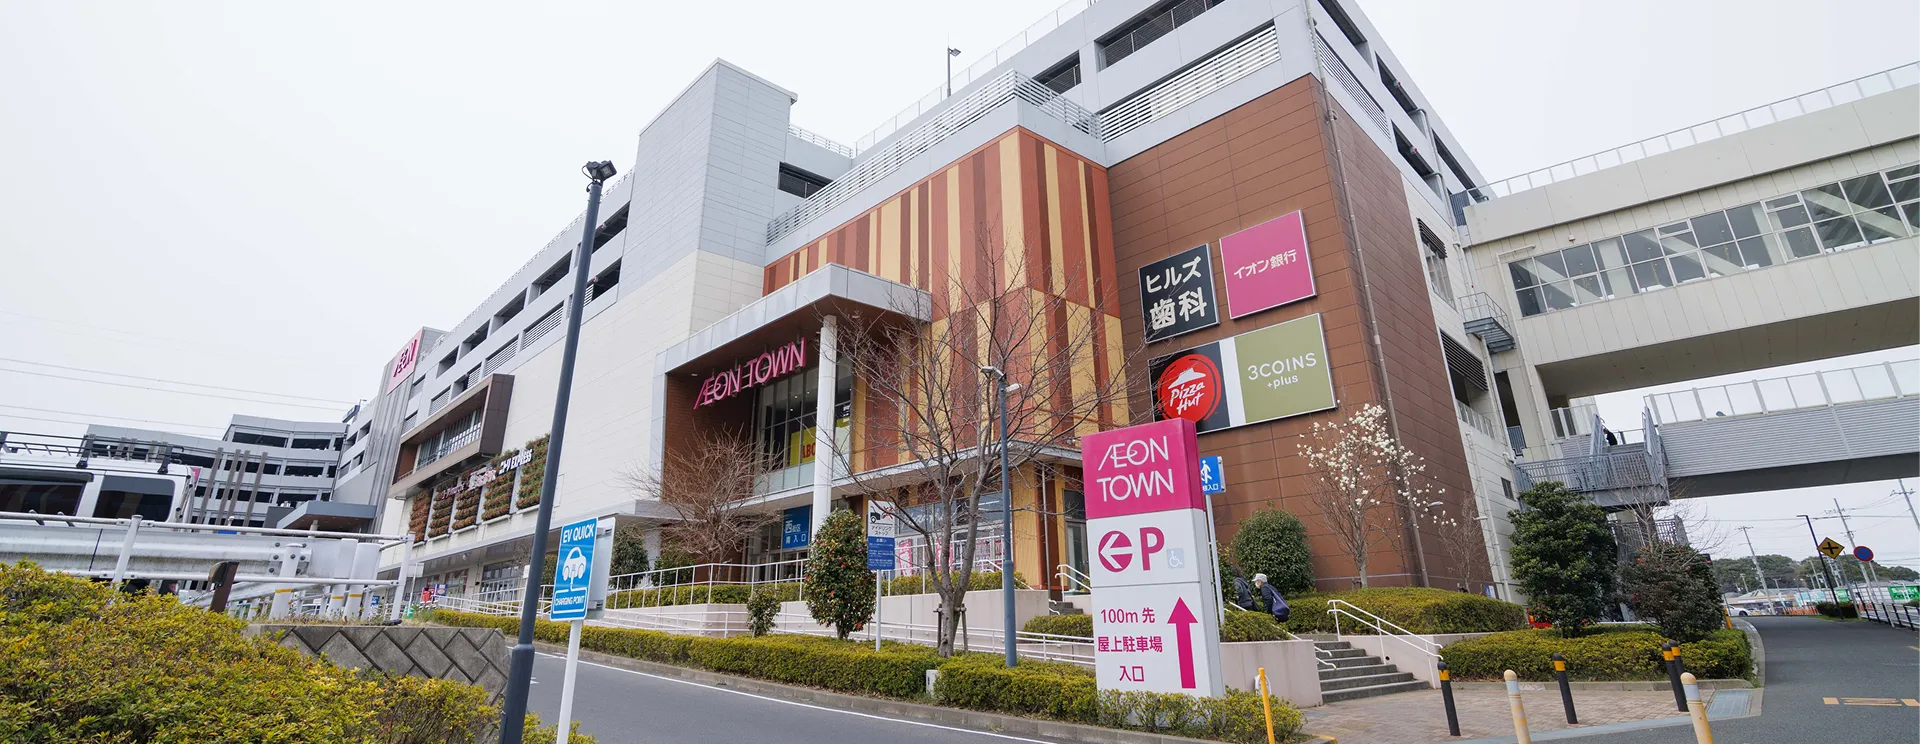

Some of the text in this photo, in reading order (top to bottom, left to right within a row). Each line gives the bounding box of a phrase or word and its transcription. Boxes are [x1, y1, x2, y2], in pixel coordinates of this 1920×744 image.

[1146, 256, 1201, 293] ヒルズ
[1234, 249, 1297, 279] イオン銀行
[1150, 287, 1207, 330] 歯科
[747, 337, 806, 387] TOWN
[1247, 352, 1317, 381] 3COINS
[1169, 381, 1206, 407] Pizza
[1177, 392, 1205, 415] Hut
[1096, 468, 1174, 502] TOWN
[563, 523, 595, 543] EV QUICK
[1140, 527, 1165, 571] P
[573, 595, 585, 604] POINT
[1101, 607, 1155, 623] 100m 先
[1098, 636, 1163, 653] 屋上駐車場
[1119, 666, 1145, 682] 入口
